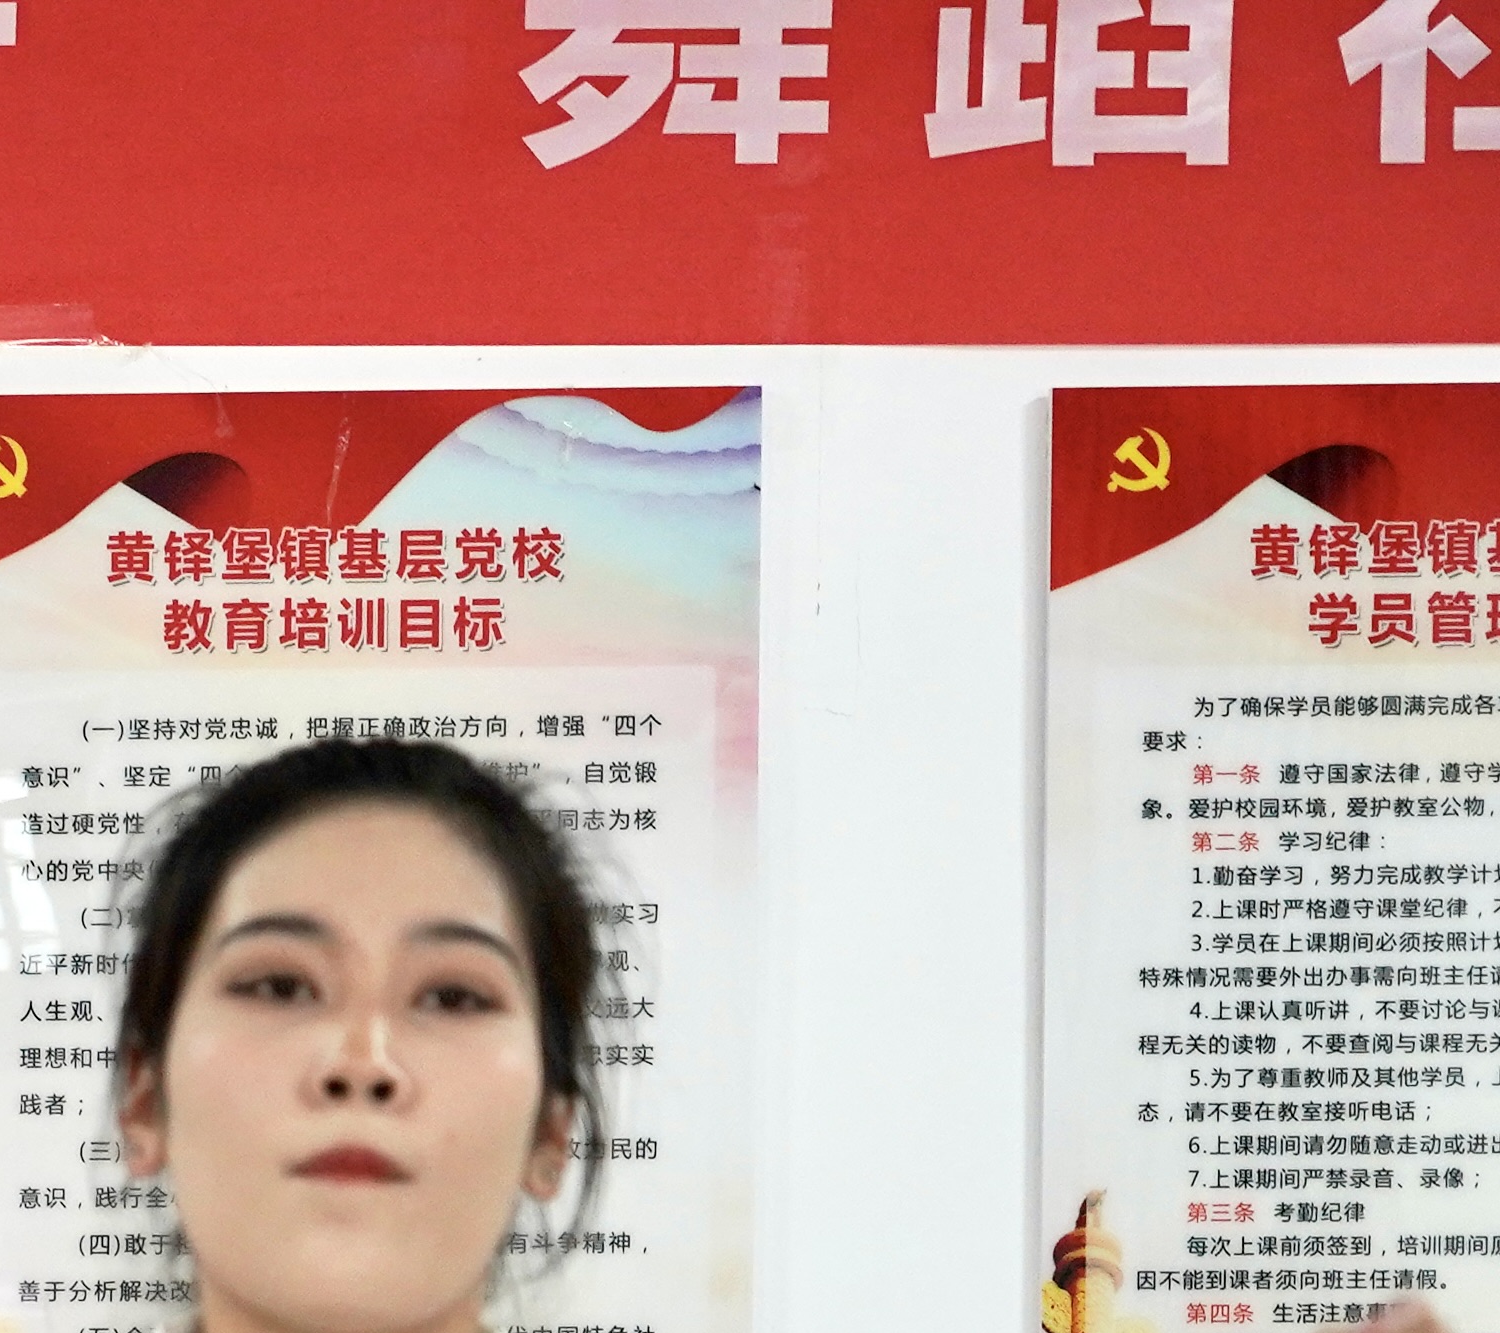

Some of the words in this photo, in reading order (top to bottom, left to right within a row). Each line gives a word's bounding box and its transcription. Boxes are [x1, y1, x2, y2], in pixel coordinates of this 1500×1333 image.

[106, 527, 564, 582] 黄铎堡镇基层党校
[1250, 519, 1500, 577] 黄铎堡镇
[163, 598, 505, 651] 教育培训目标
[1194, 695, 1500, 717] 为了确保学员能够圆满完成各
[1193, 764, 1260, 785] 第一条
[1192, 832, 1259, 852] 第二条
[21, 860, 158, 882] 心的党中央
[1188, 1202, 1254, 1222] 第三条
[1274, 1202, 1365, 1223] 考勤纪律
[1187, 1303, 1253, 1324] 第四条
[1272, 1303, 1398, 1324] 生活注意事
